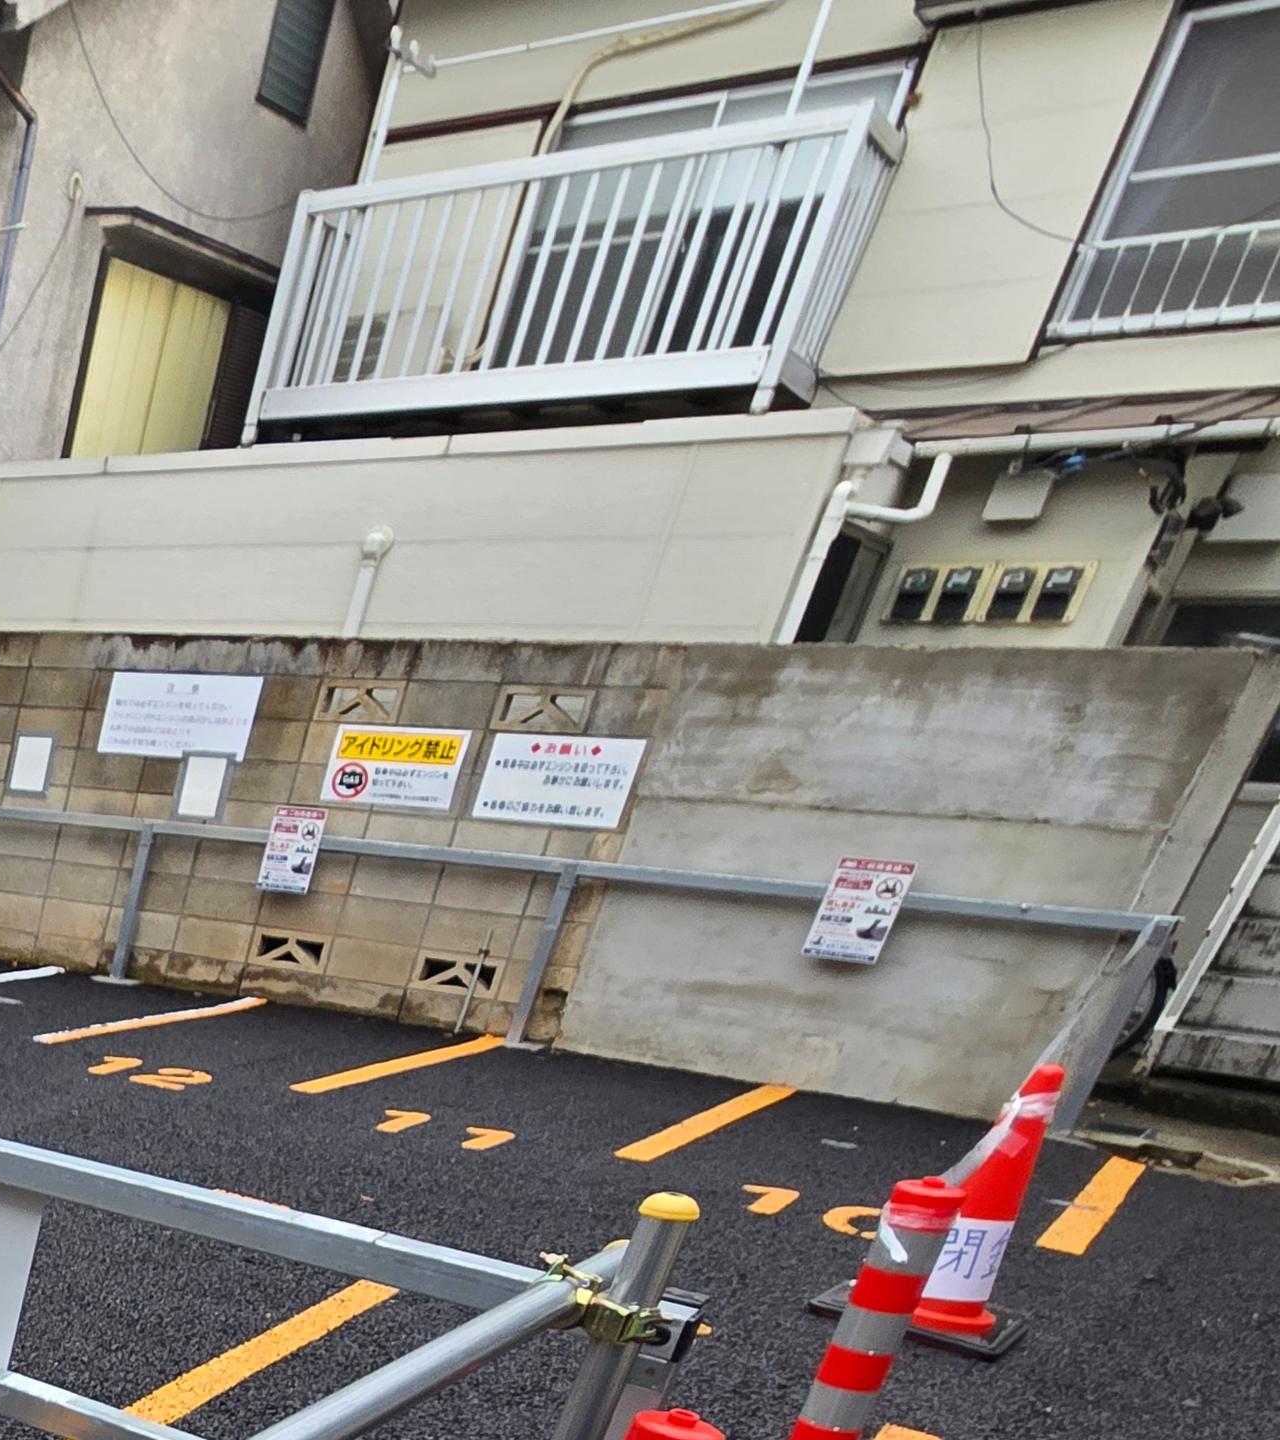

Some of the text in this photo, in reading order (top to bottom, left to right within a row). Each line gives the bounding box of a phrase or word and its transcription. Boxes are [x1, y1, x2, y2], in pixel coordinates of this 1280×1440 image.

[341, 736, 457, 760] アイドリング禁止
